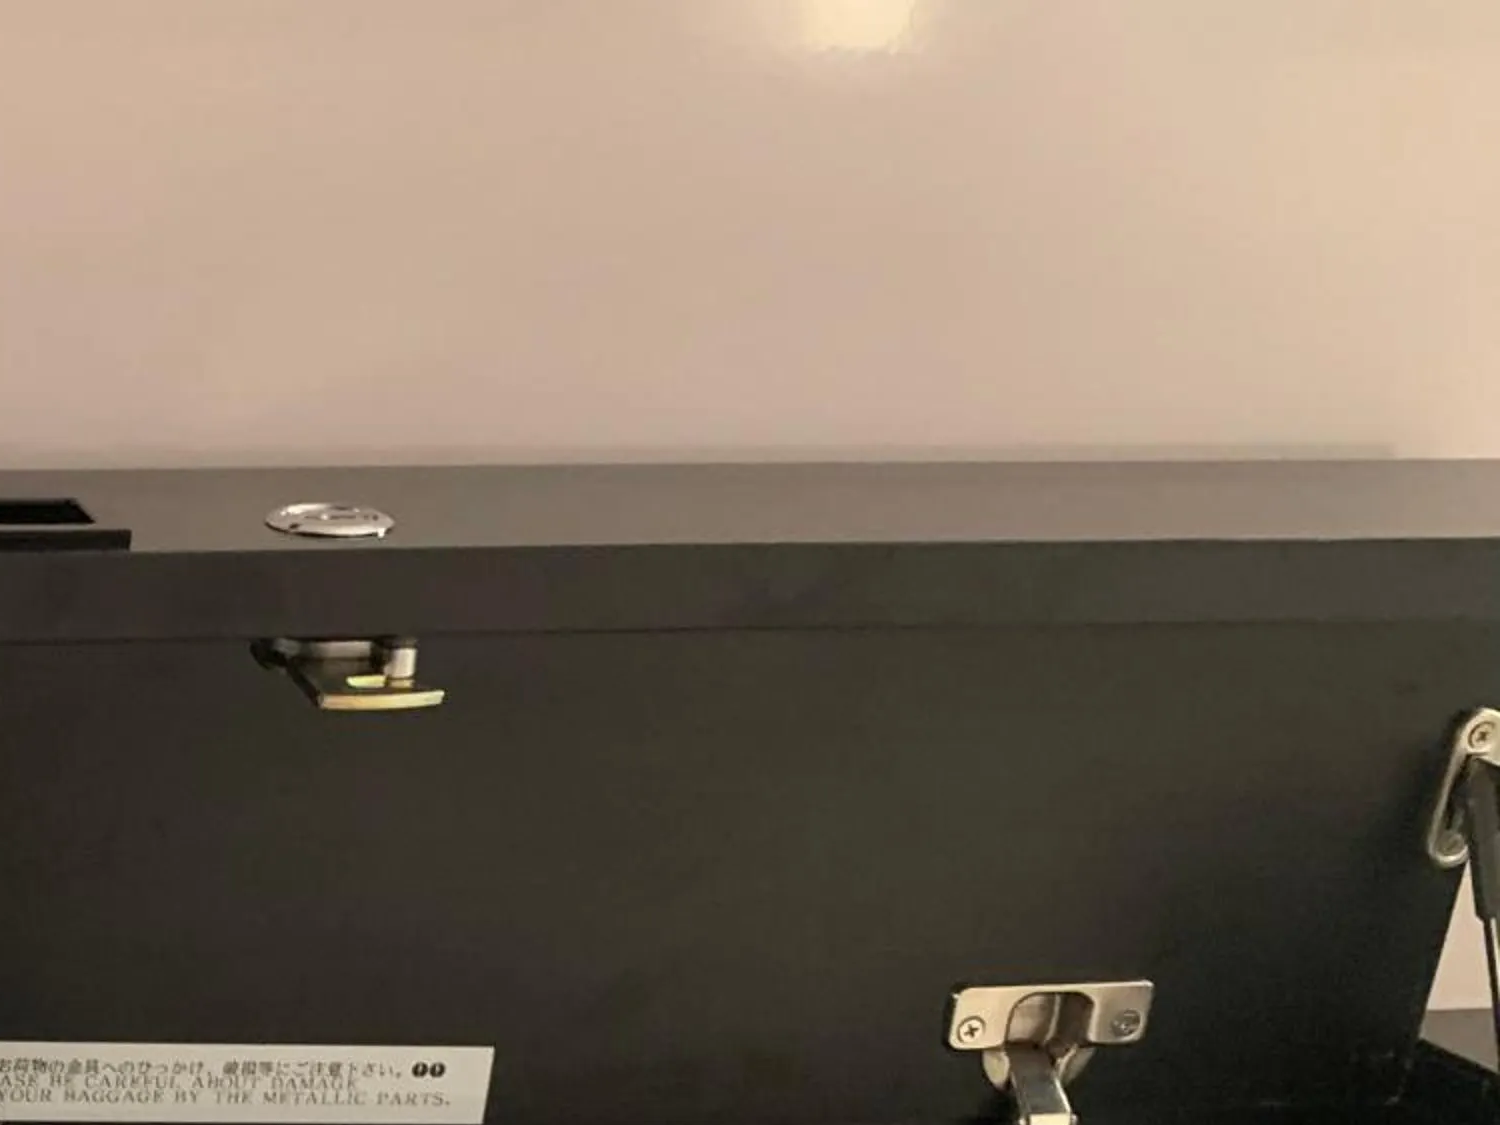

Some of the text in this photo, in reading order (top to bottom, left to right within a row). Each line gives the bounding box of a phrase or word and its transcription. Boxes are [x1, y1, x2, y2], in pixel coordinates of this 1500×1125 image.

[84, 1074, 181, 1088] CAREFUL
[192, 1075, 261, 1089] ABOUT
[271, 1077, 357, 1090] DAMAGE
[64, 1089, 164, 1104] BAGGAGE
[174, 1090, 199, 1104] BY
[216, 1091, 252, 1105] THE
[263, 1091, 368, 1106] METALLIC
[377, 1091, 451, 1106] PARTS.
